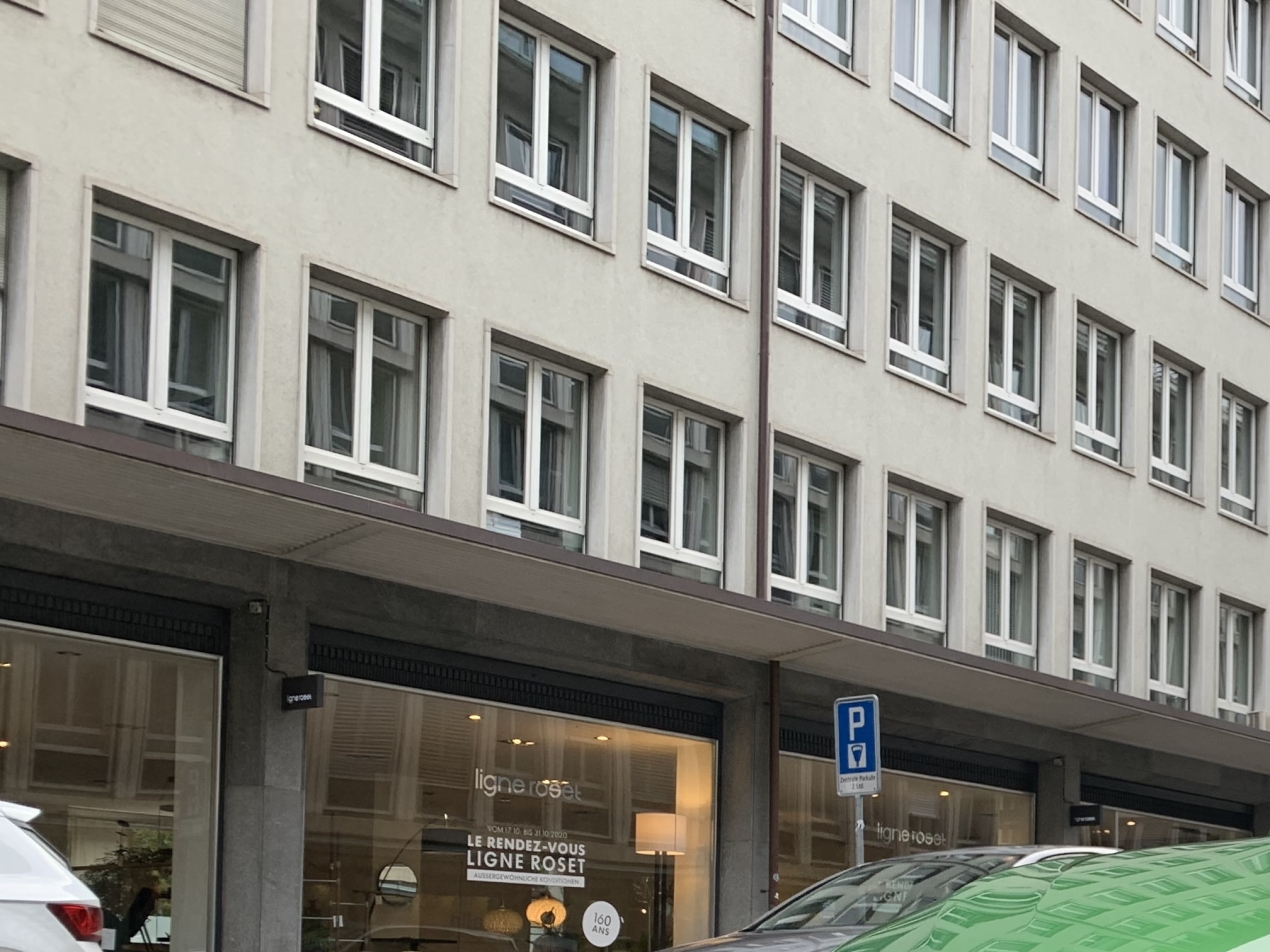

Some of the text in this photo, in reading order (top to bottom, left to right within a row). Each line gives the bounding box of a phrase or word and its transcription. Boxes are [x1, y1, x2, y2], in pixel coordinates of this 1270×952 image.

[848, 706, 866, 742] P
[475, 768, 582, 801] ligne roset
[467, 834, 586, 856] LE RENDEZ-VOUS
[877, 822, 947, 846] ligne roset
[467, 850, 586, 874] LIGNE ROSET
[592, 925, 610, 936] ANS
[594, 912, 611, 926] 160
